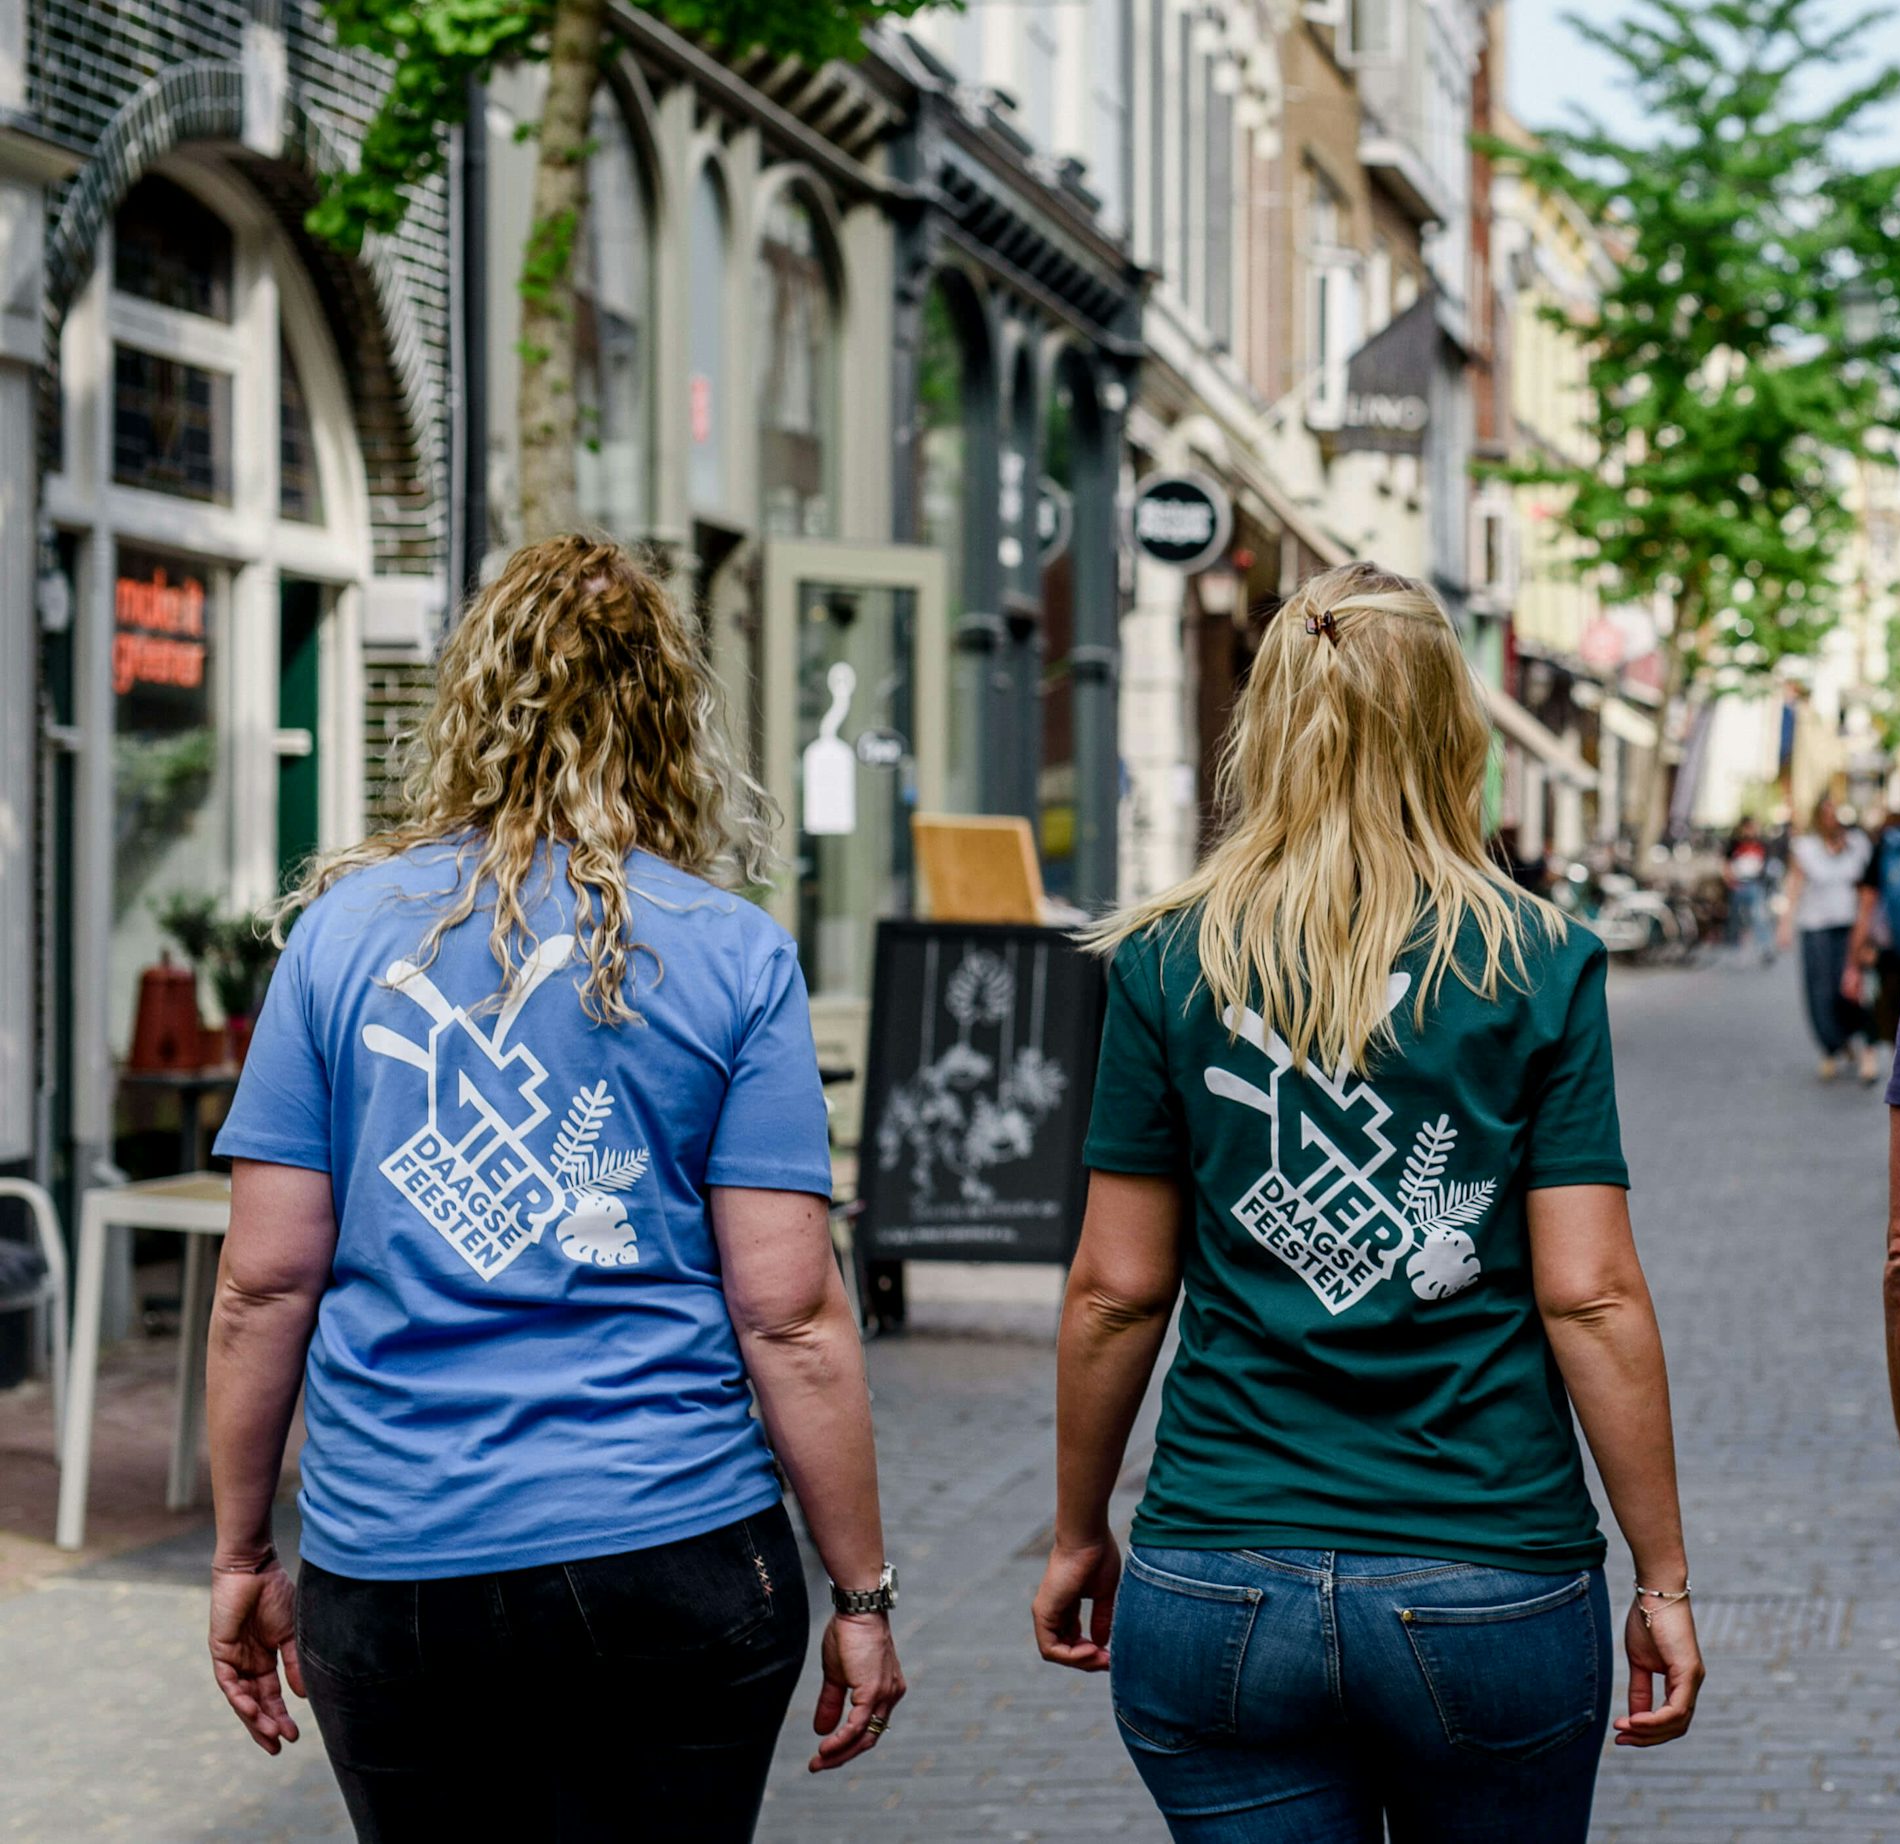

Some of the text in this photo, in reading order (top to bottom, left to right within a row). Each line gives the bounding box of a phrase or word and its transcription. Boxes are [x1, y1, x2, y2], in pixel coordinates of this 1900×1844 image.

[390, 1154, 503, 1270] FEESTEN
[412, 1135, 522, 1250] DAAGSE
[1258, 1175, 1374, 1287] DAAGSE
[1240, 1197, 1353, 1306] FEESTEN
